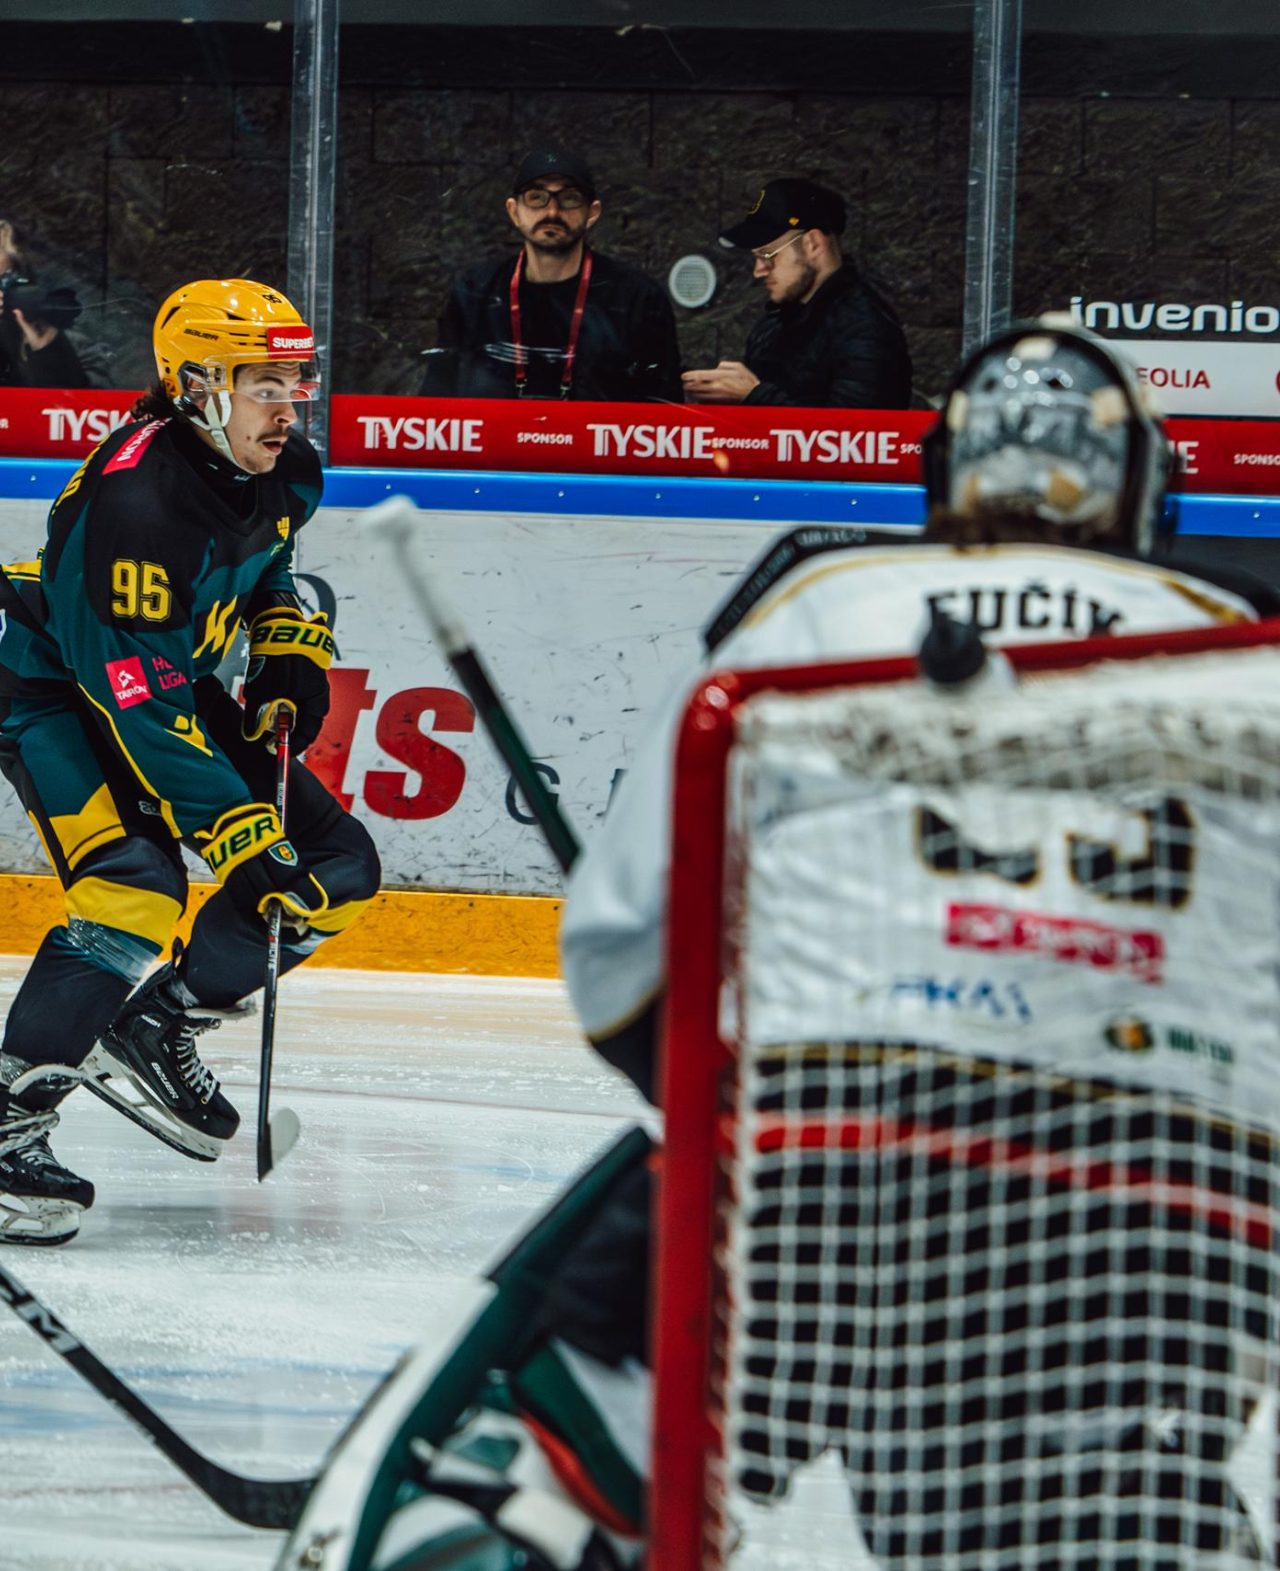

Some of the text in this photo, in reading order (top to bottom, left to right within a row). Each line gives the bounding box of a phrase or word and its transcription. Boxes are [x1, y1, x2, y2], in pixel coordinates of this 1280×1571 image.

[1070, 296, 1280, 334] invenio
[183, 328, 220, 341] BAUER
[1136, 367, 1211, 390] EOLIA
[41, 408, 132, 442] TYSK
[357, 416, 900, 465] TYSKIE SPONSOR TYSKIE SPONSOR TYSKIE
[1233, 453, 1280, 466] SPONSO
[111, 558, 172, 624] 95
[207, 815, 276, 870] UER
[150, 1061, 180, 1100] BAUER
